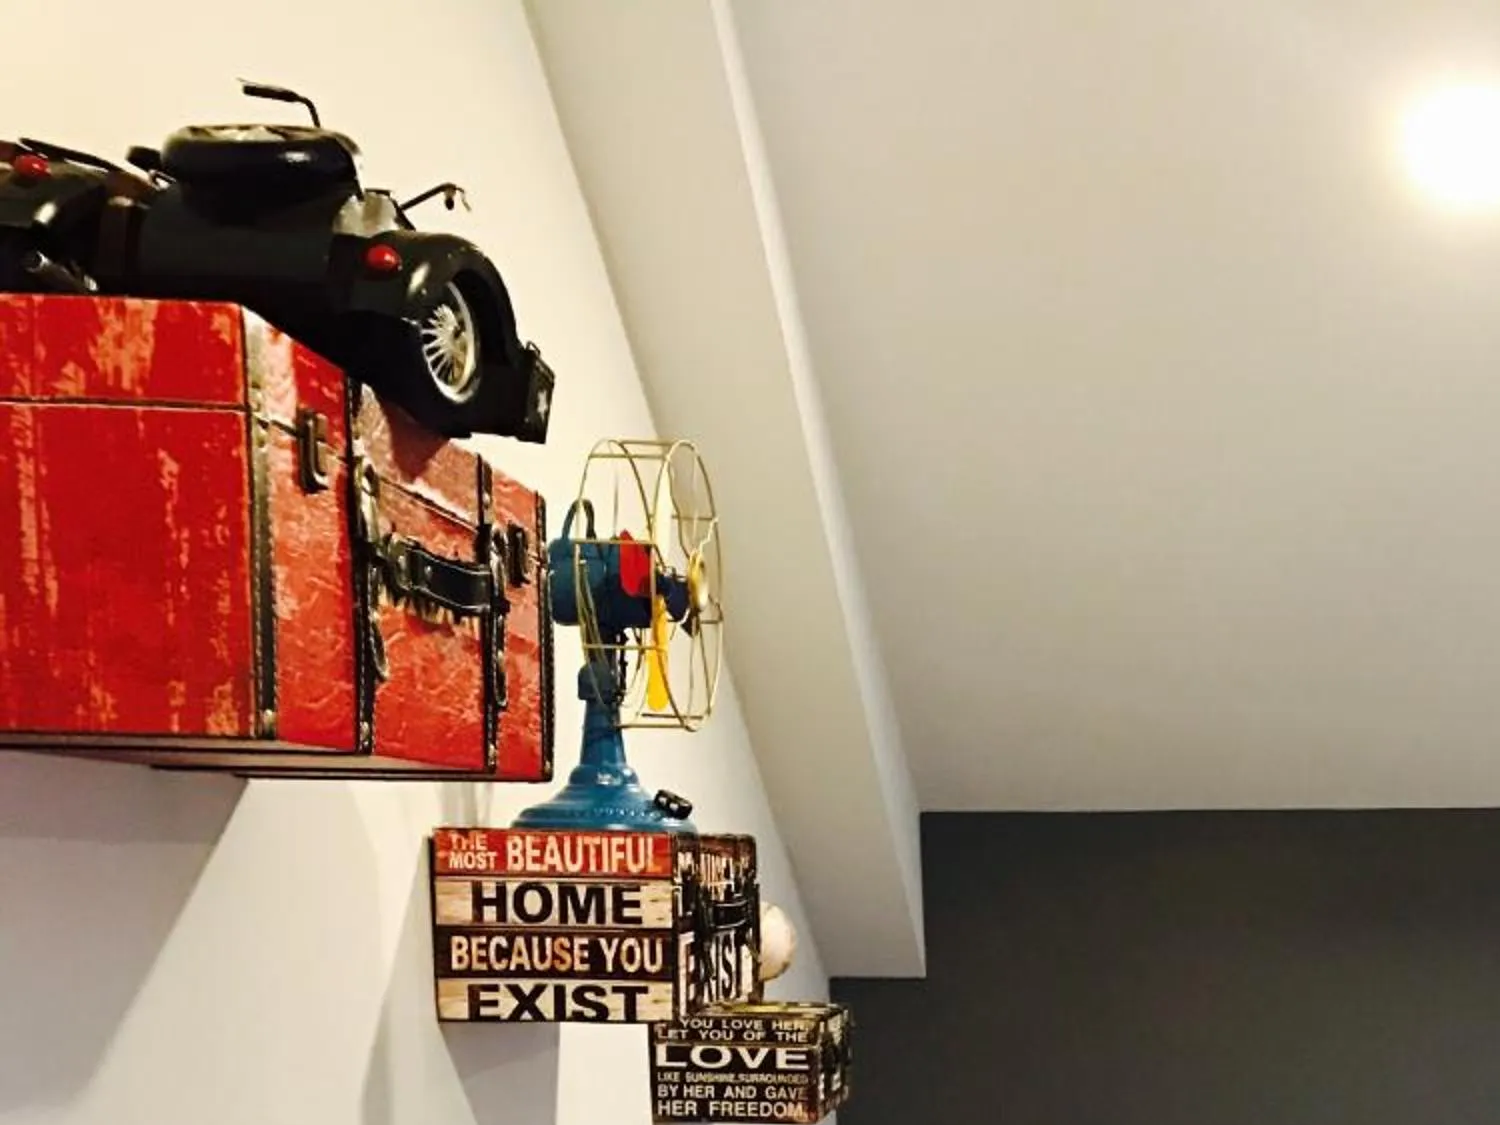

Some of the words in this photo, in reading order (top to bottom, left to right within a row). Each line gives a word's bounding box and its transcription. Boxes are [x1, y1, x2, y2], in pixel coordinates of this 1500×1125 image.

[450, 832, 488, 850] THE
[449, 852, 498, 870] MOST
[506, 835, 663, 874] BEAUTIFUL
[471, 881, 643, 924] HOME
[451, 935, 591, 972] BECAUSE
[598, 937, 664, 974] YOU
[467, 983, 649, 1021] EXIST
[679, 1018, 713, 1030] YOU
[721, 1019, 764, 1031] LOVE
[657, 1028, 689, 1040] LET
[699, 1029, 735, 1041] YOU
[743, 1029, 767, 1041] OF
[775, 1030, 808, 1043] THE
[655, 1043, 810, 1071] LOVE
[657, 1071, 681, 1083] LIKE
[657, 1084, 679, 1098] BY
[683, 1085, 715, 1099] HER
[723, 1085, 757, 1099] AND
[765, 1086, 809, 1101] GAVE
[657, 1100, 698, 1117] HER
